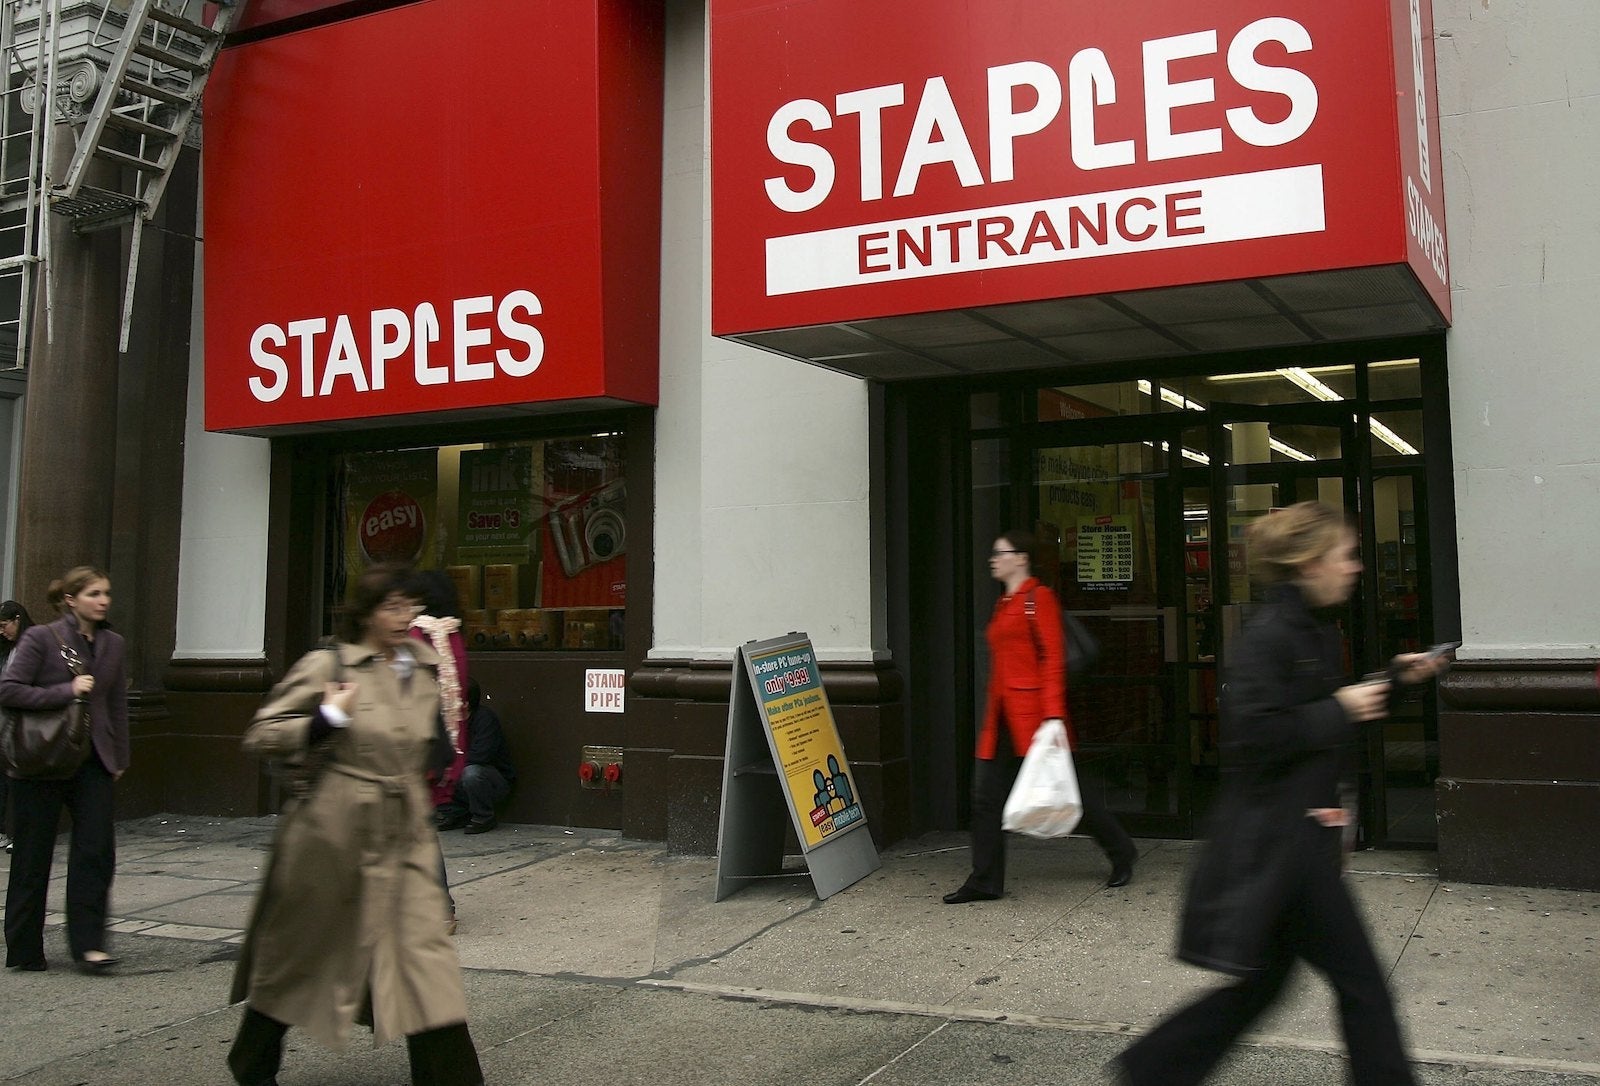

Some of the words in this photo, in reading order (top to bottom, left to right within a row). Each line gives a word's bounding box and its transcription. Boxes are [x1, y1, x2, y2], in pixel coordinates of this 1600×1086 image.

[764, 17, 1319, 212] STAPLES
[858, 190, 1205, 275] ENTRANCE
[1407, 175, 1447, 286] STAPLES
[248, 289, 545, 403] STAPLES
[1047, 455, 1068, 476] make
[1049, 483, 1080, 506] products
[366, 505, 417, 537] easy
[467, 510, 502, 530] Save
[503, 507, 521, 529] $3
[1081, 525, 1102, 533] Store
[1104, 525, 1128, 533] Hours
[475, 533, 490, 542] your
[491, 532, 506, 541] next
[752, 660, 779, 675] In-store
[778, 657, 788, 669] PC
[787, 652, 811, 666] tune-up
[586, 673, 625, 688] STAND
[764, 674, 786, 694] only
[783, 667, 811, 688] $9.99!
[590, 693, 621, 707] PIPE
[766, 705, 781, 716] Make
[781, 701, 794, 712] other
[811, 808, 826, 822] STAPLES
[820, 820, 834, 834] easy
[834, 810, 850, 826] mobile
[850, 806, 861, 819] tech
